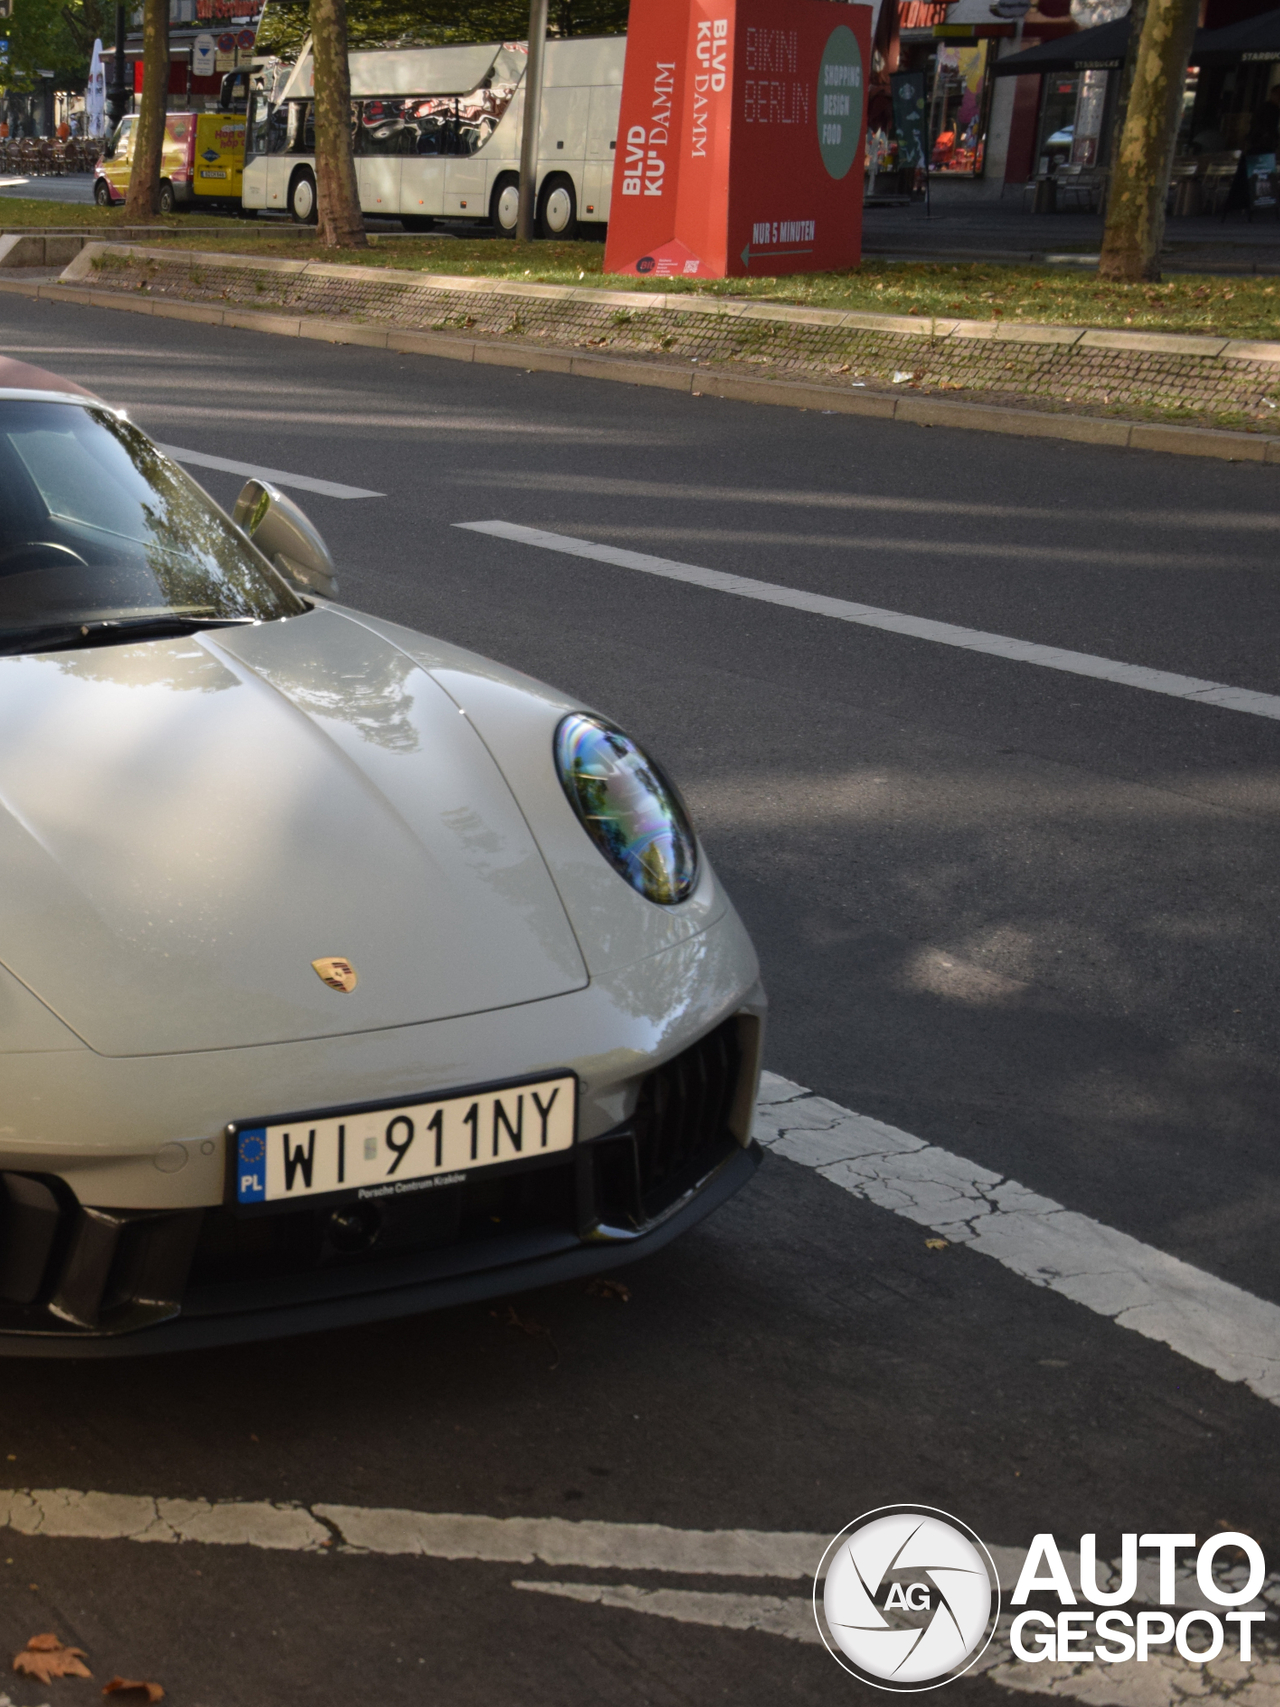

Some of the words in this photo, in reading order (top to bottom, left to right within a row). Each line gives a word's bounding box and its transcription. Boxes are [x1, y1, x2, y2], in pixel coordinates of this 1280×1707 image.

[711, 19, 728, 92] BLVD
[746, 27, 798, 73] BIKINI
[1074, 59, 1120, 69] STARBUCKS
[824, 64, 860, 88] SHOPPING
[744, 80, 809, 124] BERLIN
[823, 93, 850, 116] DESIGN
[215, 130, 235, 142] Hop
[220, 139, 238, 149] hop
[822, 123, 842, 145] FOOD
[622, 125, 646, 196] BLVD
[753, 222, 770, 244] NUR
[772, 222, 778, 242] 5
[282, 1124, 346, 1191] WI
[385, 1087, 561, 1176] 911NY
[240, 1174, 263, 1193] PL
[357, 1188, 394, 1200] Porsche
[394, 1179, 433, 1194] Centrum
[434, 1173, 467, 1187] Kraków
